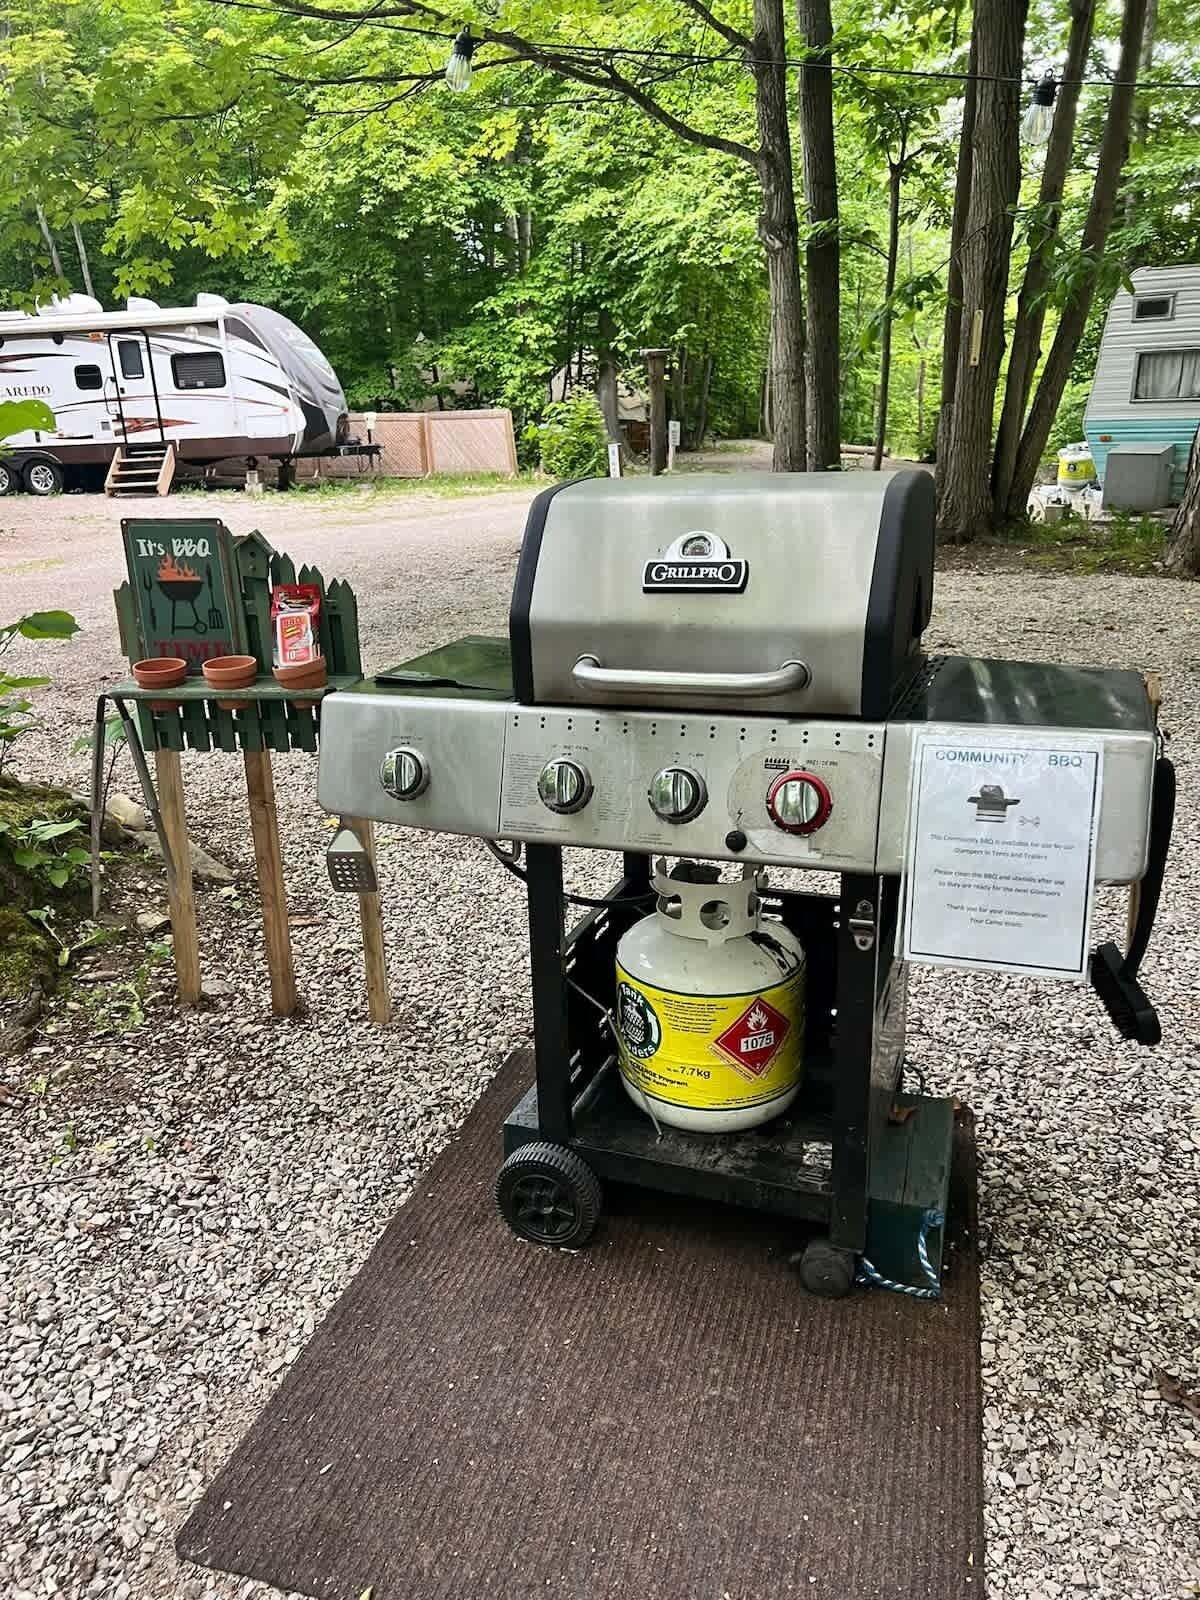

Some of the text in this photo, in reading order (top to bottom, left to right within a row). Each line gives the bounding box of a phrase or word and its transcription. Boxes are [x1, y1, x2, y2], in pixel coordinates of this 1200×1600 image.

[0, 385, 50, 397] AREDO
[171, 537, 212, 557] BBQ
[154, 640, 229, 658] TIME
[935, 750, 1082, 768] COMMUNITY BBQ
[743, 1033, 772, 1050] 1075
